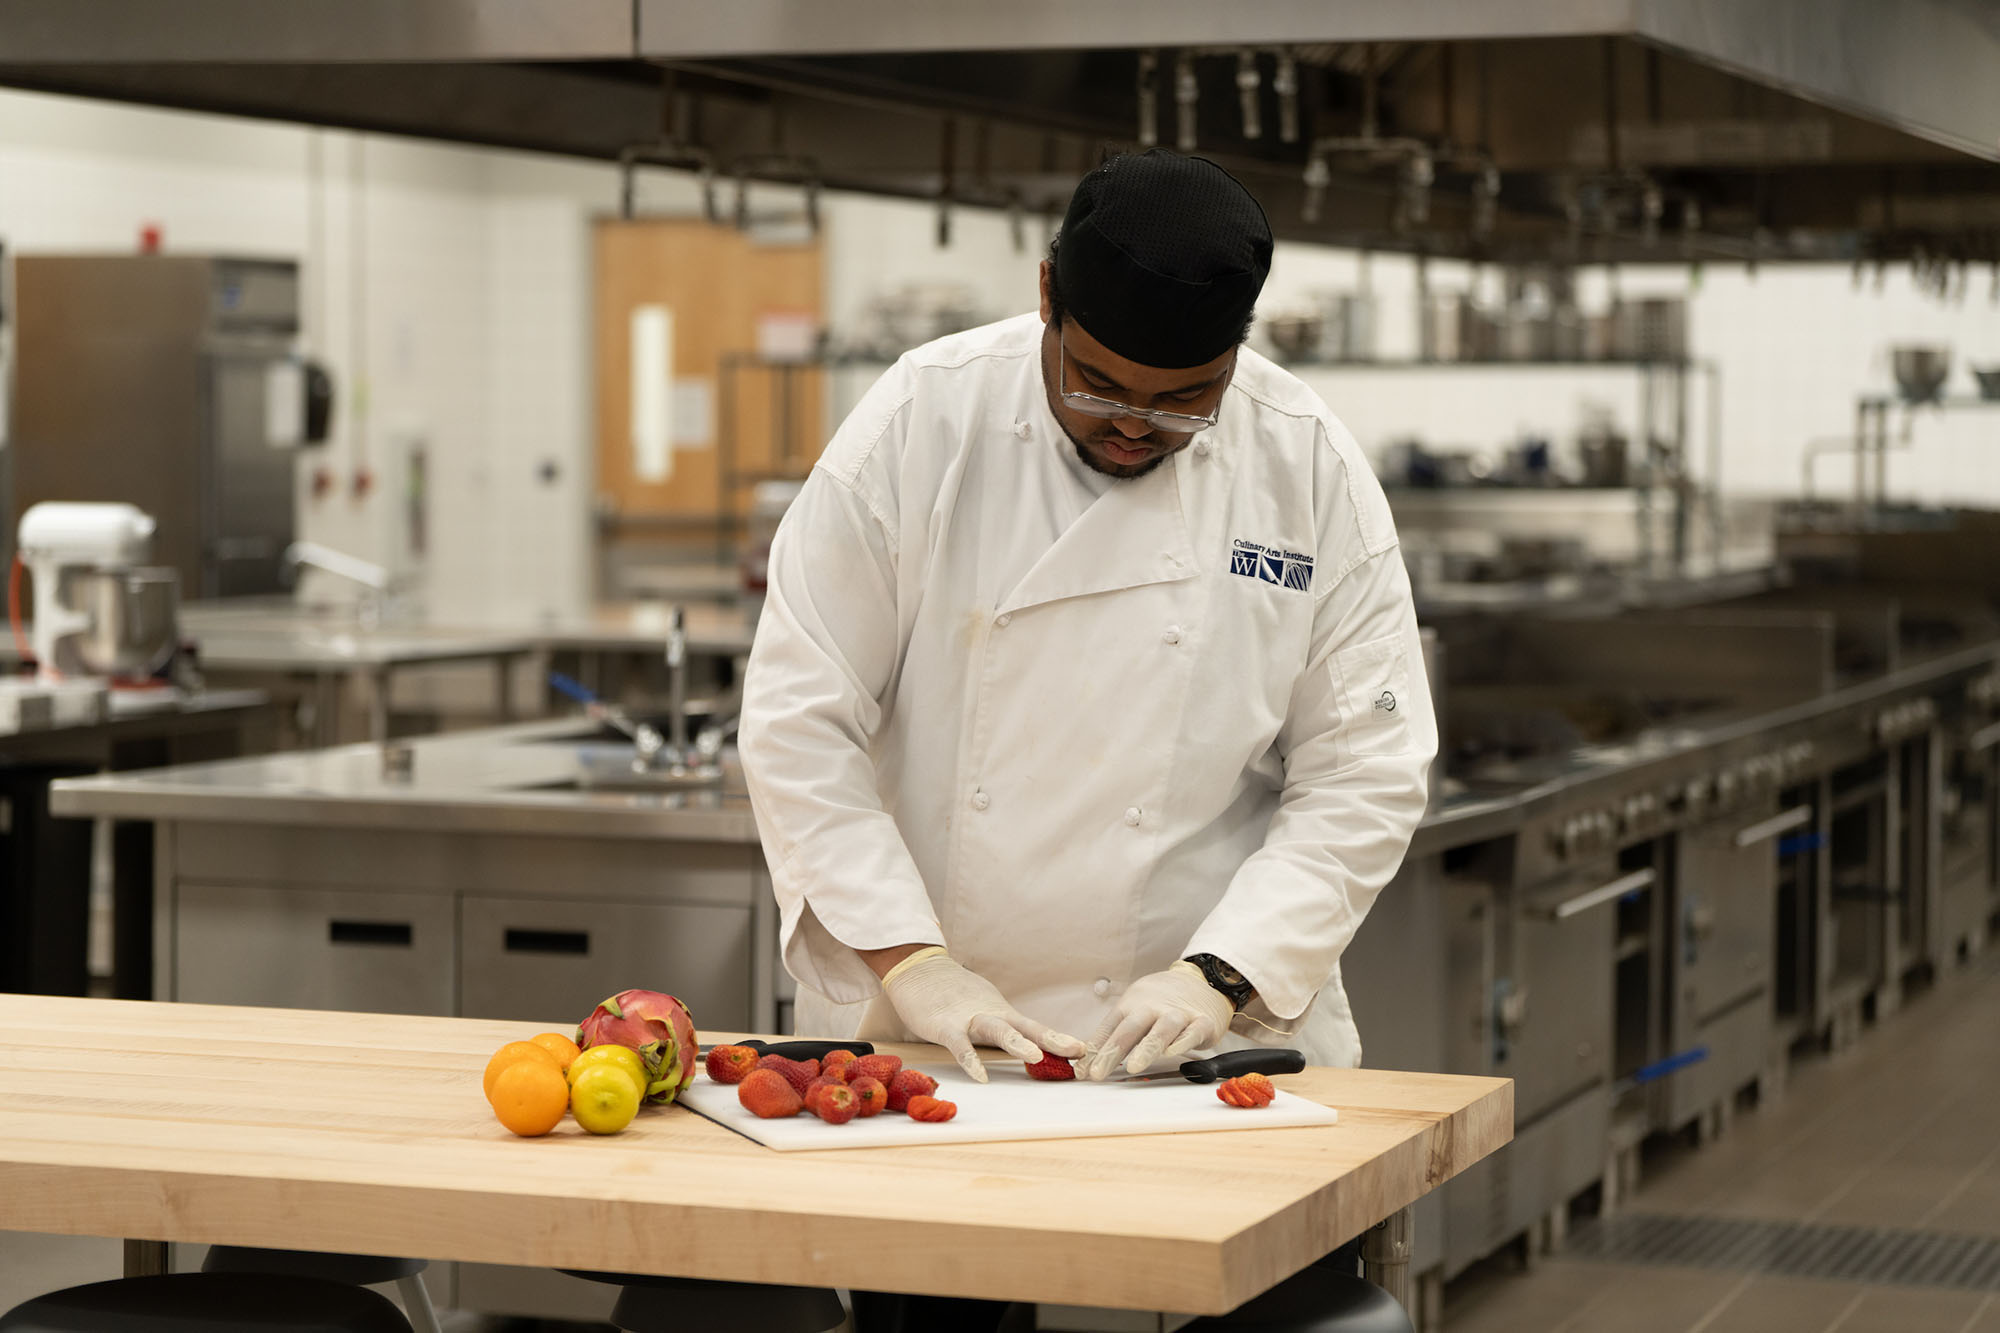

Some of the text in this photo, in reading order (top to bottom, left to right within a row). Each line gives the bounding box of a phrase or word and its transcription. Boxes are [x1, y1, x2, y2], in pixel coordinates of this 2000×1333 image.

[1234, 539, 1313, 563] Culinary Arts Institute
[1233, 557, 1257, 576] W
